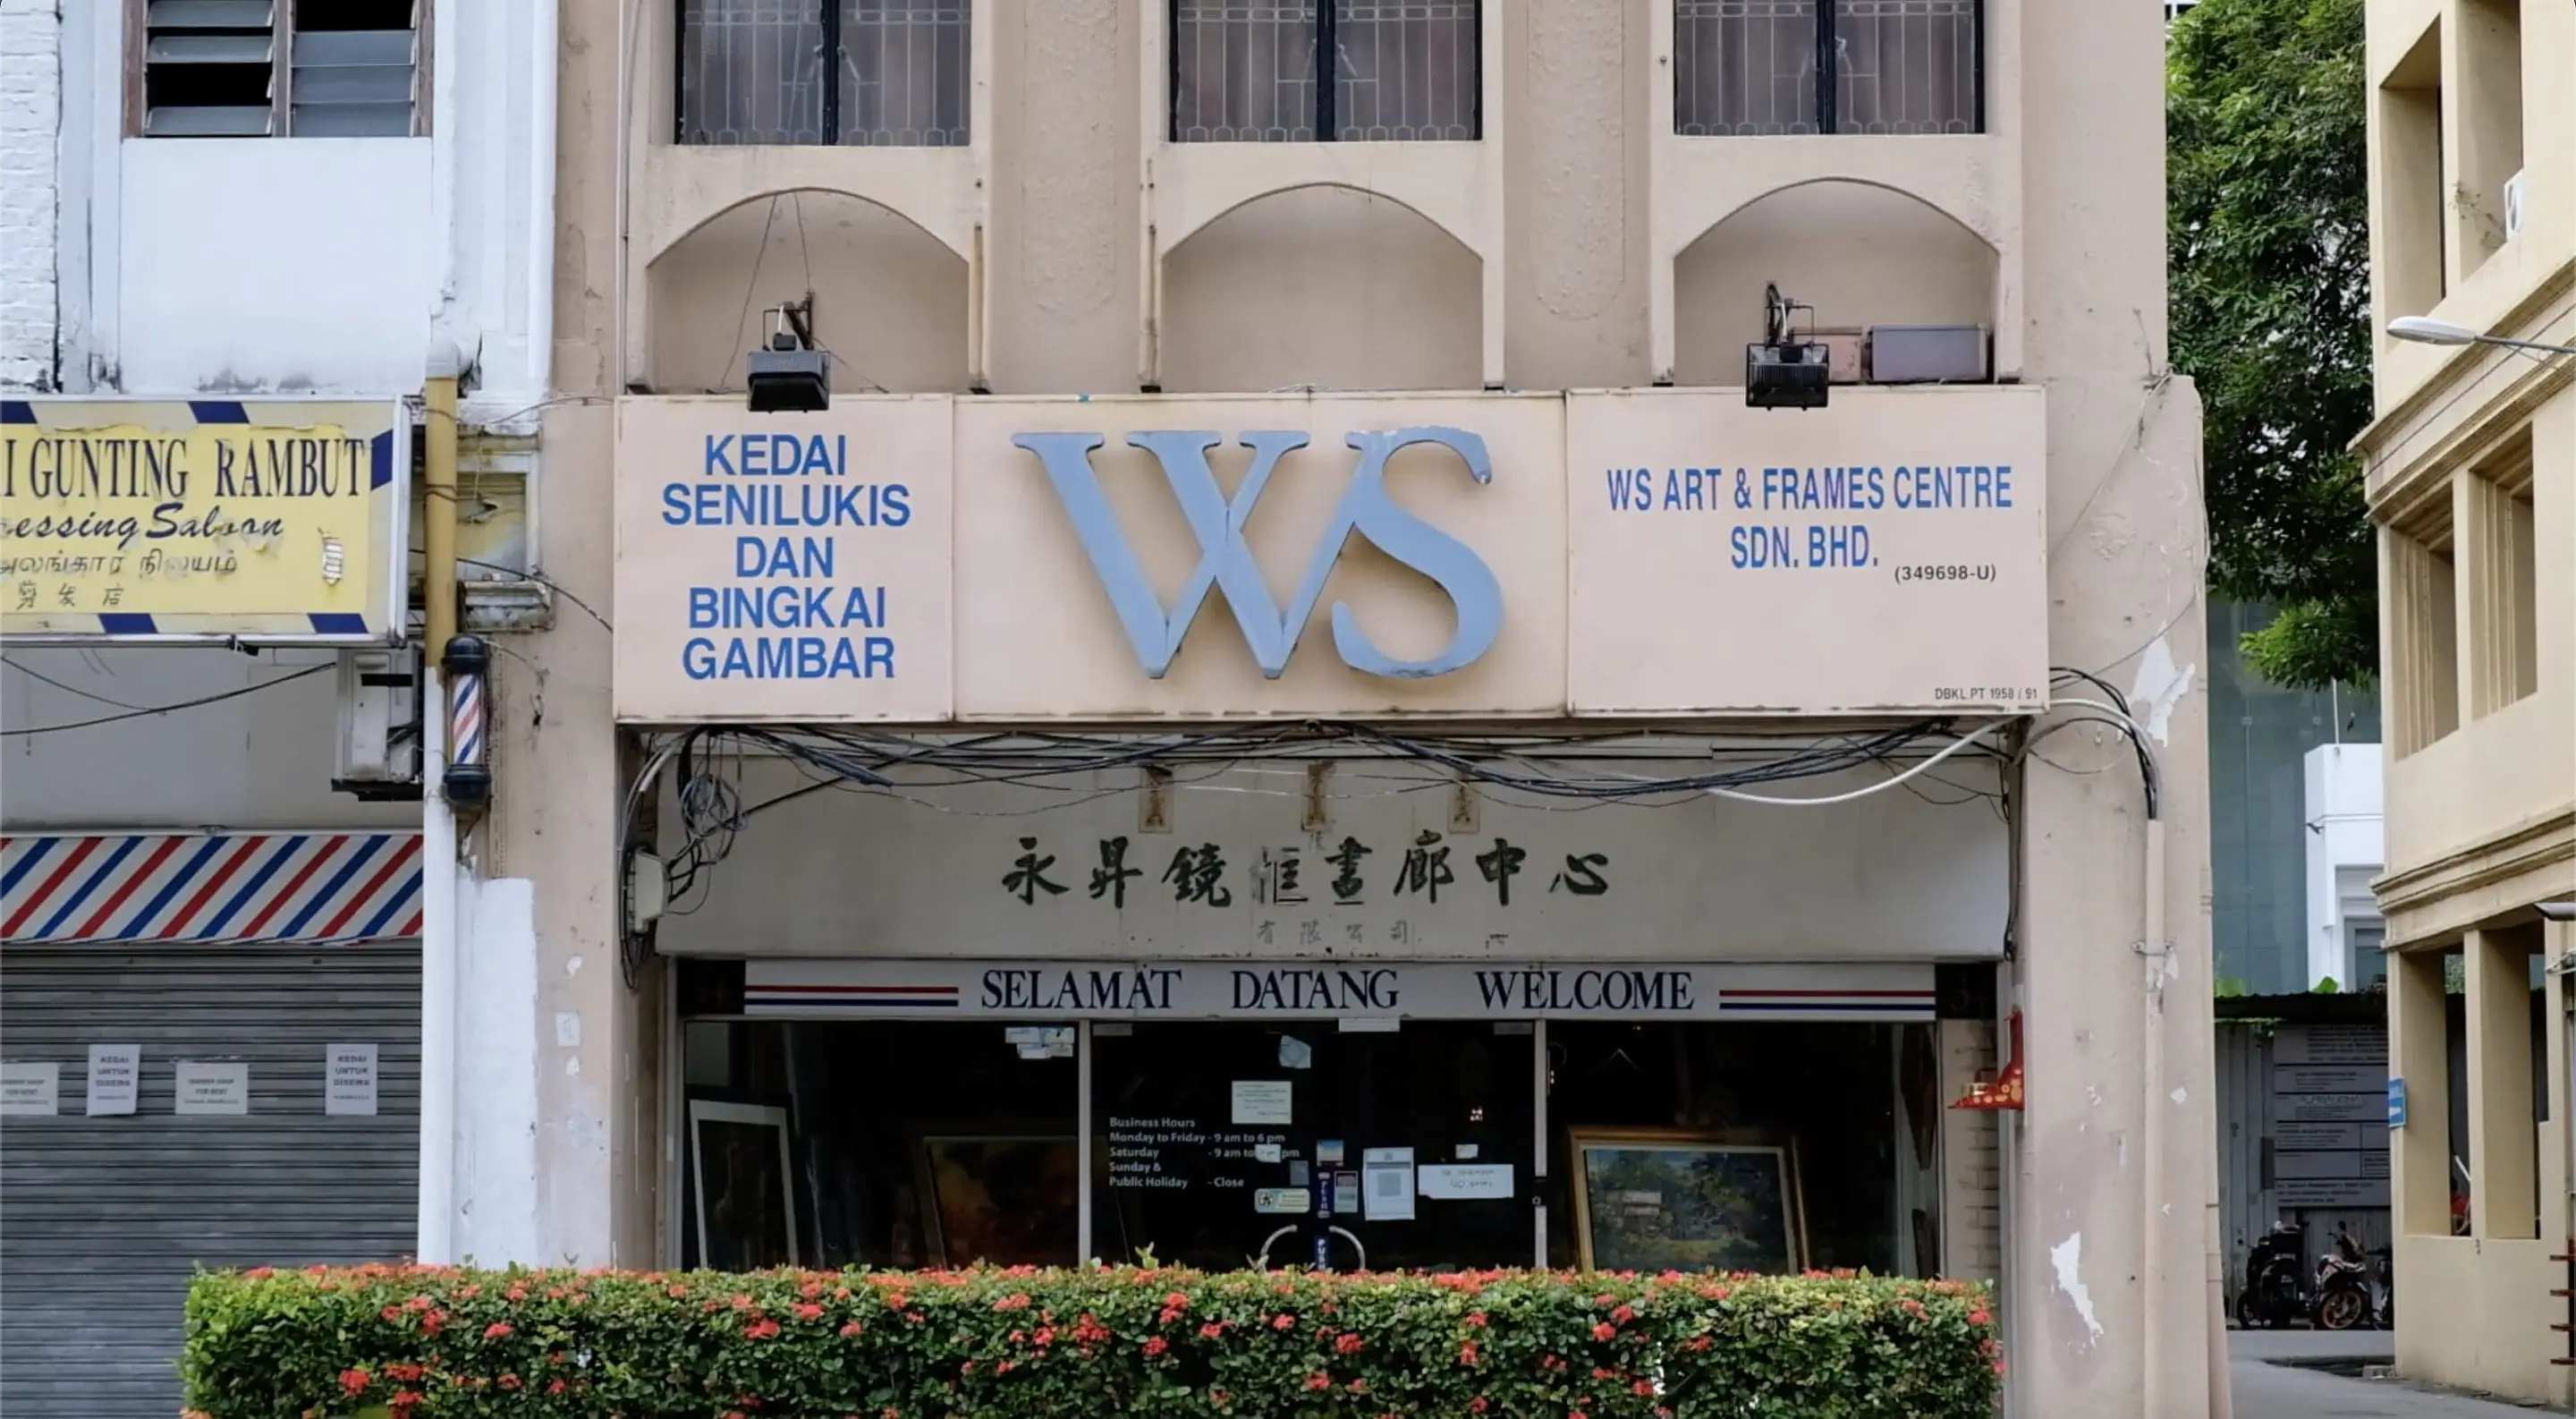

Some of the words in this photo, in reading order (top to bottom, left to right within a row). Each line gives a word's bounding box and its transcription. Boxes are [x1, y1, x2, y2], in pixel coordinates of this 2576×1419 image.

[30, 437, 188, 499] GUNTING
[215, 438, 365, 497] RAMBUT
[705, 434, 846, 476] KEDAI
[662, 483, 911, 527] SENILUKIS
[1606, 467, 1653, 511] WS
[1663, 468, 1723, 511] ART
[1733, 467, 1752, 509] &
[1762, 465, 1885, 510] FRAMES
[1893, 465, 2013, 509] CENTRE
[736, 536, 835, 579] DAN
[1011, 426, 1504, 680] WS
[1731, 524, 1800, 569] SDN.
[1808, 523, 1878, 567] BHD.
[1894, 564, 1997, 585] (349698-U)
[689, 586, 886, 629] BINGKAI
[682, 636, 896, 680] GAMBAR
[1935, 687, 1968, 700] DBKL
[1970, 687, 1986, 700] PT
[2024, 687, 2038, 699] 91
[981, 969, 1183, 1009] SELAMAT
[1231, 969, 1401, 1009] DATANG
[1474, 971, 1696, 1010] WELCOME
[1109, 1117, 1159, 1128] Business
[1162, 1117, 1196, 1128] Hours
[1109, 1133, 1155, 1144] Monday
[1157, 1134, 1169, 1143] to
[1171, 1133, 1207, 1145] Friday
[1214, 1134, 1222, 1143] 9
[1223, 1134, 1241, 1143] am
[1242, 1134, 1256, 1143] to
[1258, 1134, 1265, 1143] 6
[1267, 1134, 1286, 1145] pm
[1109, 1147, 1160, 1160] Saturday
[1214, 1148, 1222, 1158] 9
[1223, 1150, 1241, 1158] am
[1242, 1148, 1256, 1158] to
[1109, 1161, 1151, 1174] Sunday
[1109, 1176, 1143, 1187] Public
[1146, 1176, 1189, 1190] Holiday
[1214, 1177, 1245, 1187] Close
